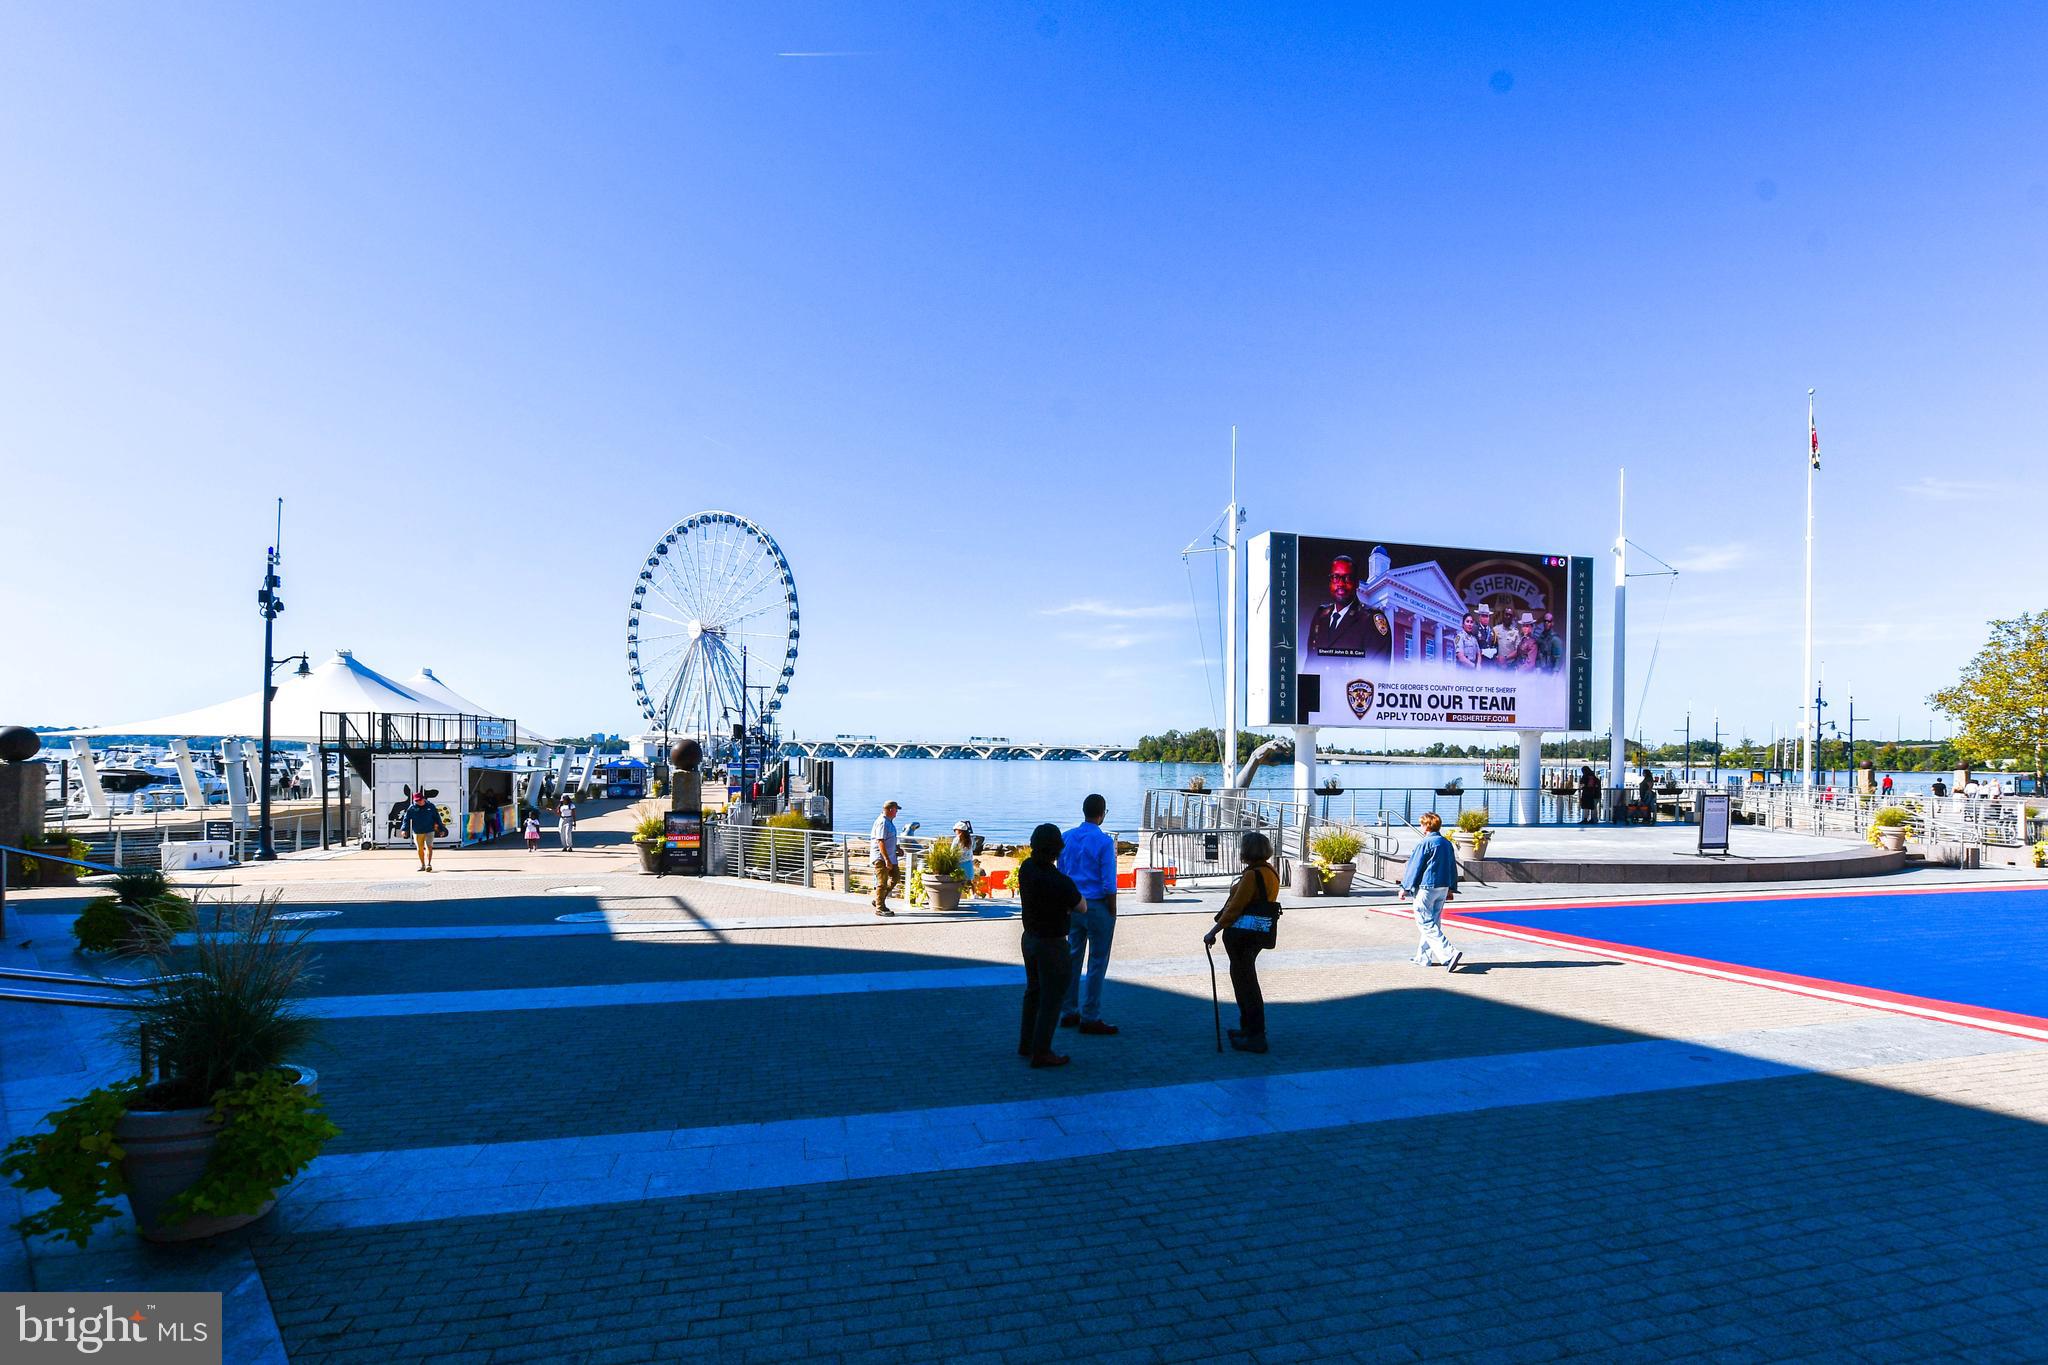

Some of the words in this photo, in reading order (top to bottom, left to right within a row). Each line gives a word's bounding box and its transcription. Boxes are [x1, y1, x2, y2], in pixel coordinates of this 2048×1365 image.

[1473, 575, 1536, 597] SHERIFF
[1376, 692, 1422, 708] JOIN
[1427, 694, 1463, 710] OUR
[1468, 695, 1516, 711] TEAM
[1376, 712, 1408, 721] APPLY
[1410, 712, 1445, 722] TODAY
[1452, 714, 1509, 722] PGSHERIFF.COM
